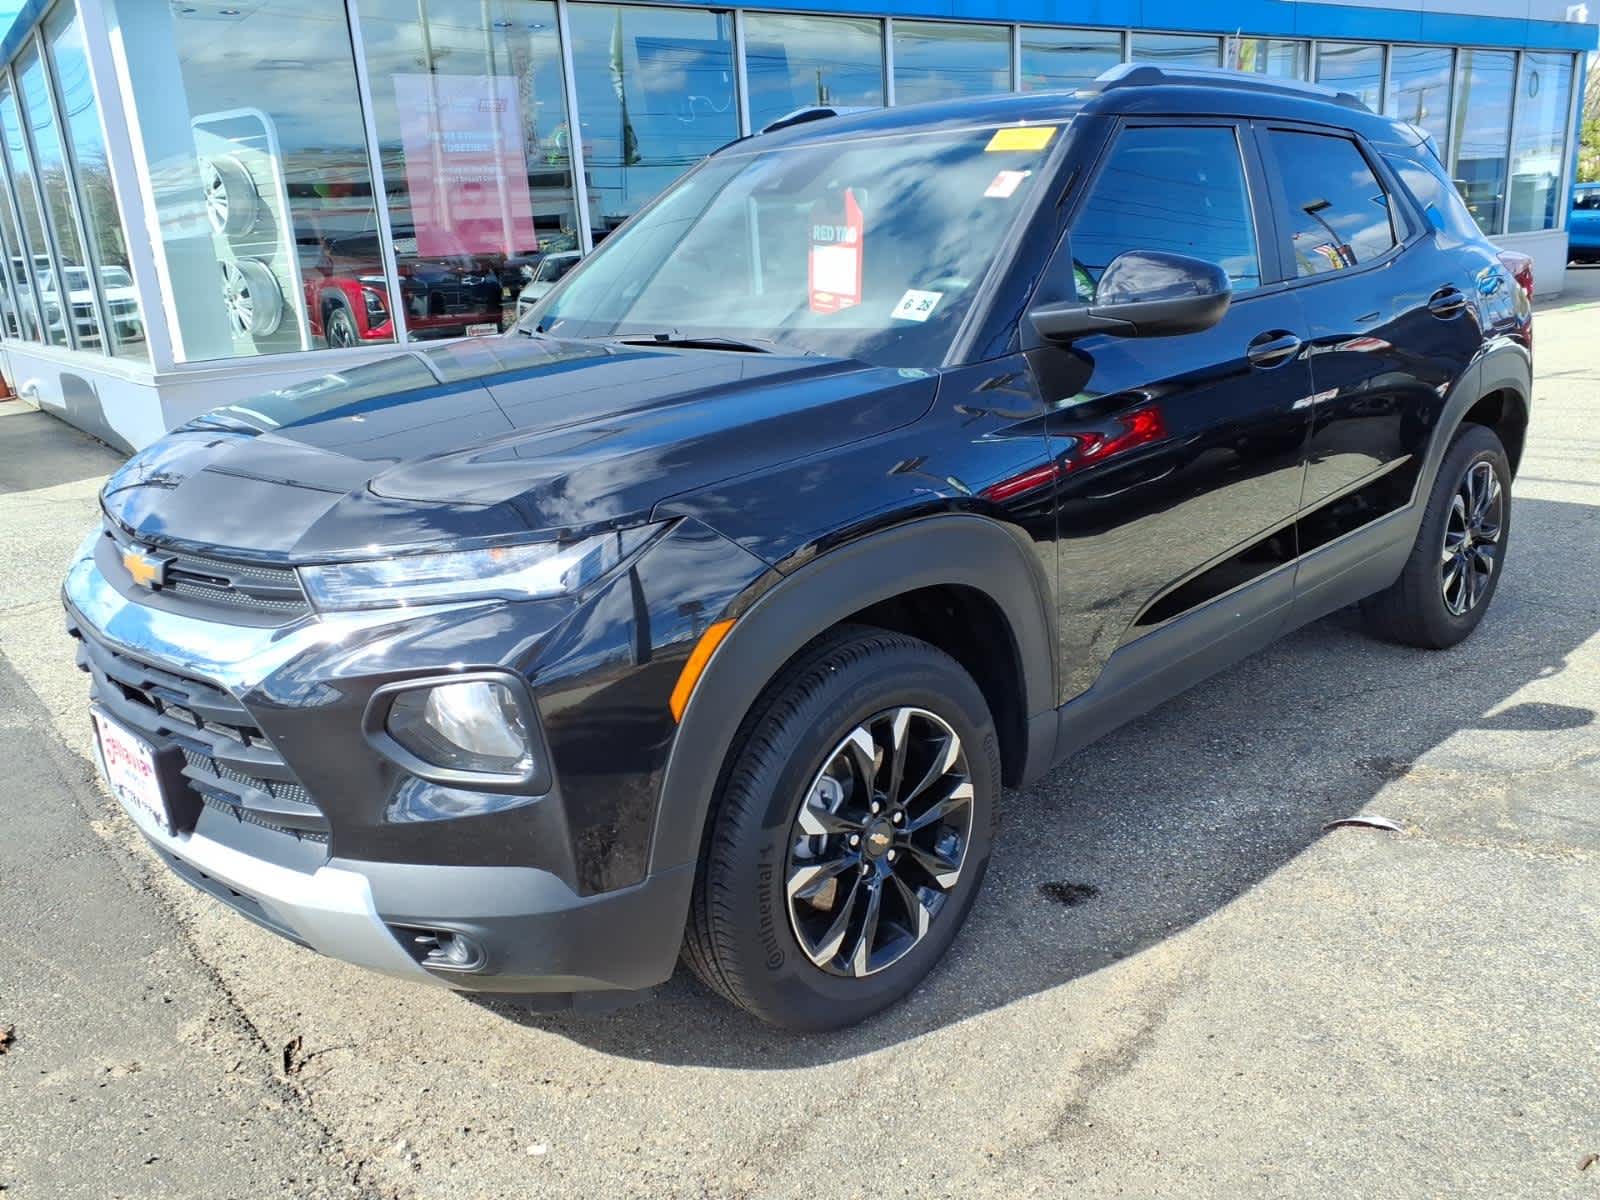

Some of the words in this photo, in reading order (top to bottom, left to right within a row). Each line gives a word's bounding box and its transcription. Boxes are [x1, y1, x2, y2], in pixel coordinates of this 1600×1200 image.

[813, 225, 834, 241] RED
[904, 299, 914, 310] 6
[758, 863, 785, 968] Continental
